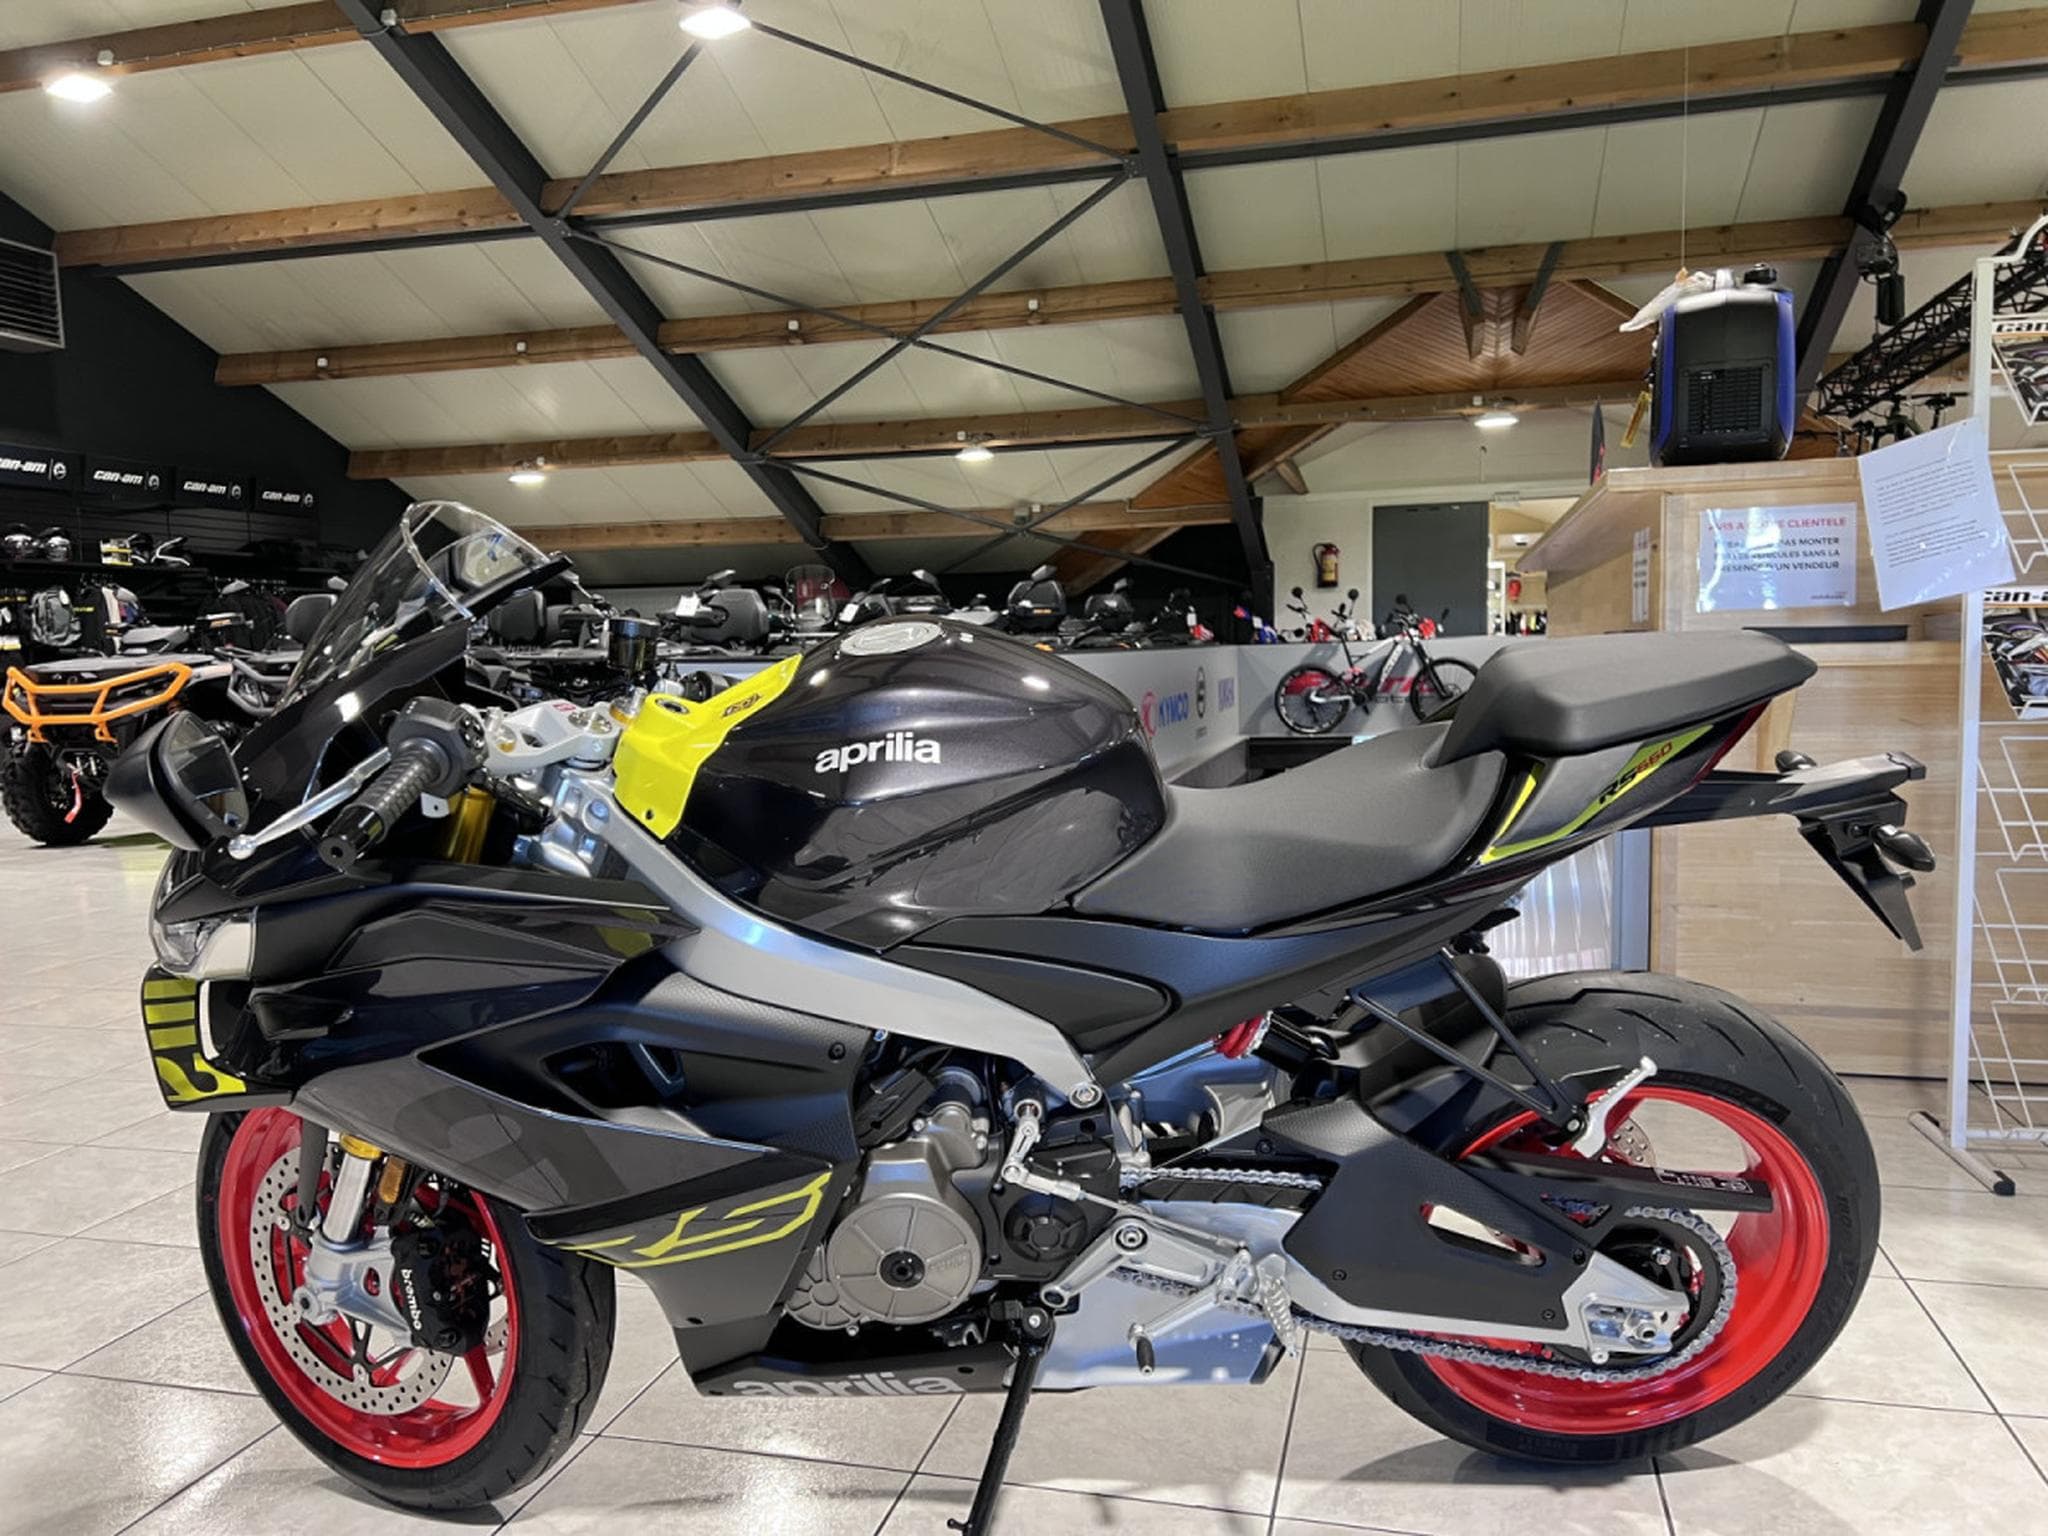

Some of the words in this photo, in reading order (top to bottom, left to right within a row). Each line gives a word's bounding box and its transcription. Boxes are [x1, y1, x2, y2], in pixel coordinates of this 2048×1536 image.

[0, 457, 47, 473] an-am
[93, 470, 143, 484] can-am
[183, 481, 227, 494] can-am
[262, 491, 301, 502] can-am
[1799, 536, 1839, 546] MONTER
[1802, 550, 1826, 558] SANS
[1792, 562, 1840, 571] VENDEUR
[1159, 692, 1188, 727] KYMCO
[815, 731, 941, 773] aprilia
[401, 1269, 422, 1331] brembo
[733, 1372, 967, 1396] aprilia
